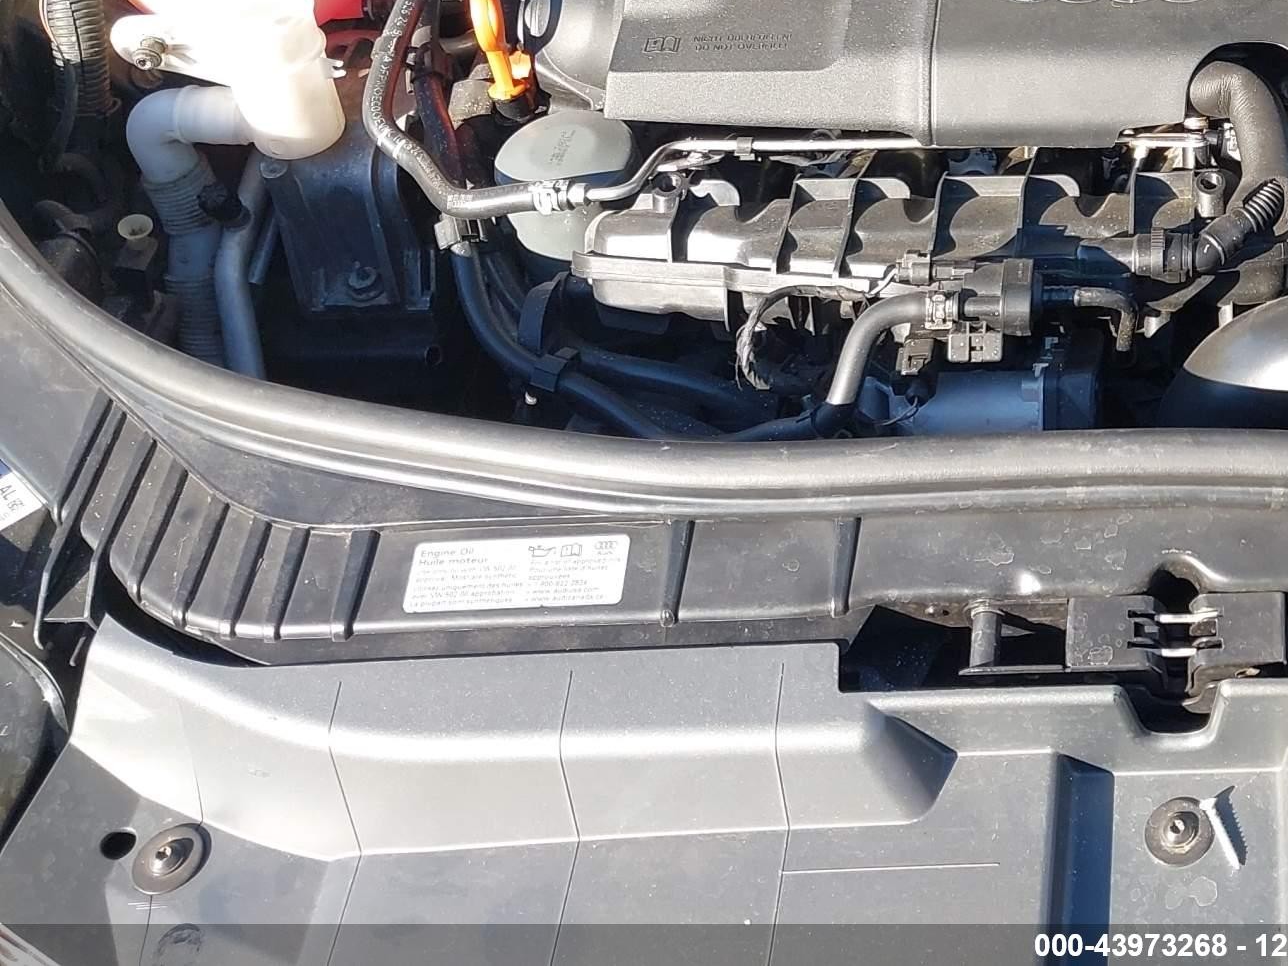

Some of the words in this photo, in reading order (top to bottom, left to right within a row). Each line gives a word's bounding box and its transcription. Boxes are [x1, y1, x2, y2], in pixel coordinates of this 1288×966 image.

[420, 549, 456, 558] Engine
[460, 547, 474, 555] Oil
[448, 557, 489, 565] moteur
